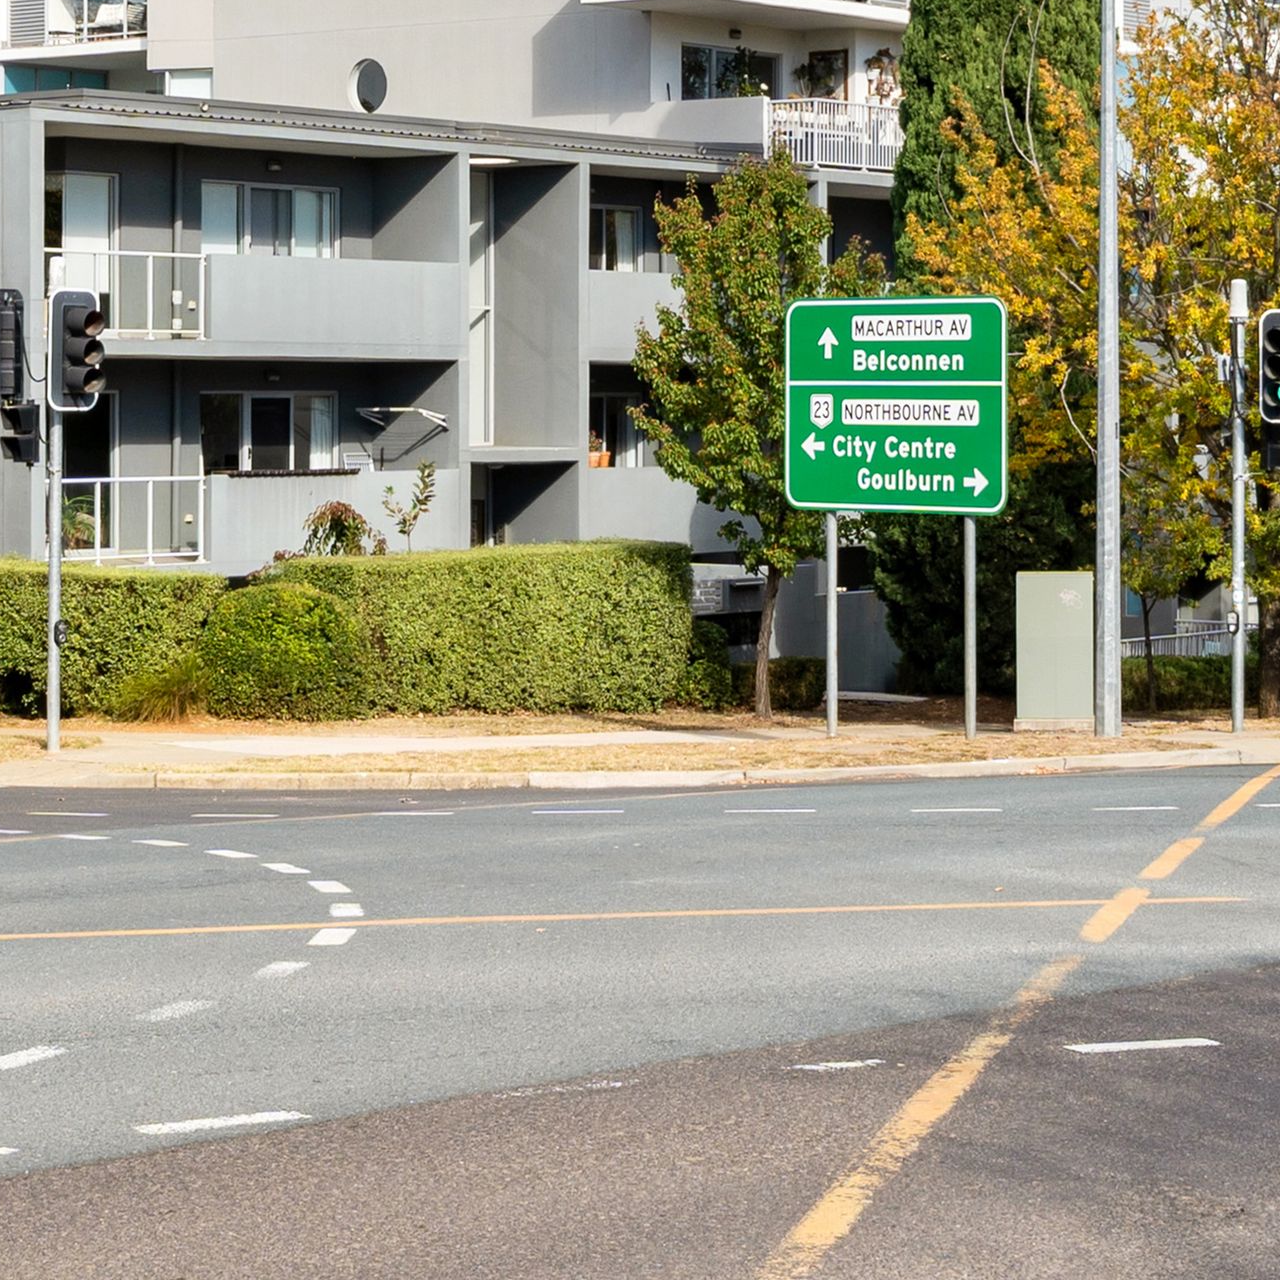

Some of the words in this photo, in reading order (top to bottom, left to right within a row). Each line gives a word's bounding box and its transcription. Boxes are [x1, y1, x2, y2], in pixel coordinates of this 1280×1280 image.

[854, 320, 943, 337] MACARTHUR
[949, 319, 968, 336] AV
[852, 349, 964, 371] Belconnen
[813, 401, 830, 419] 23
[844, 404, 951, 421] NORTHBOURNE
[957, 404, 976, 421] AV
[832, 435, 876, 463] City
[884, 436, 956, 459] Centre
[857, 467, 955, 491] Goulburn
